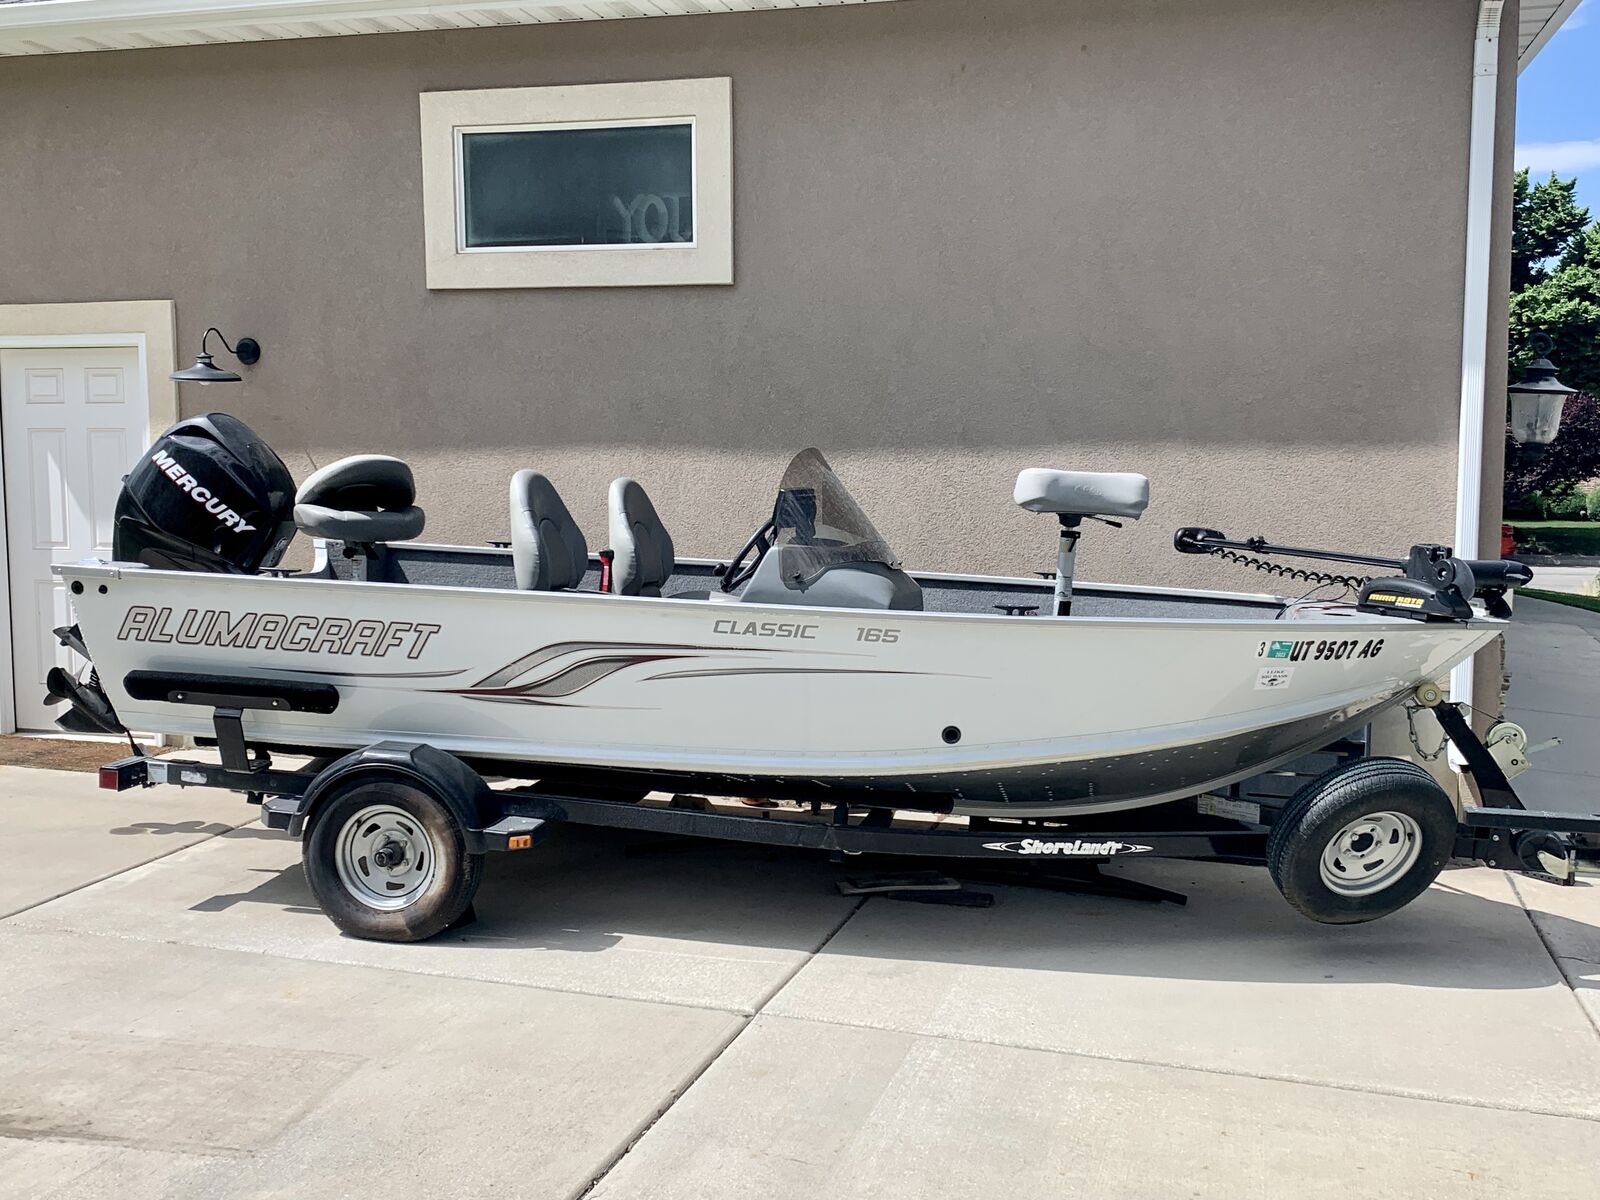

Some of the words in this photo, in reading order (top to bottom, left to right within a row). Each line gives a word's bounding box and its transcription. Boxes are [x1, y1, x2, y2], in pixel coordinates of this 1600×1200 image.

[151, 449, 256, 535] MERCURY
[117, 605, 441, 659] ALUMACRAFT
[713, 620, 819, 639] CLASSIC
[856, 627, 901, 643] 165
[1257, 641, 1266, 657] 3
[1289, 640, 1315, 661] UT
[1316, 639, 1358, 661] 9507
[1357, 639, 1384, 659] AG
